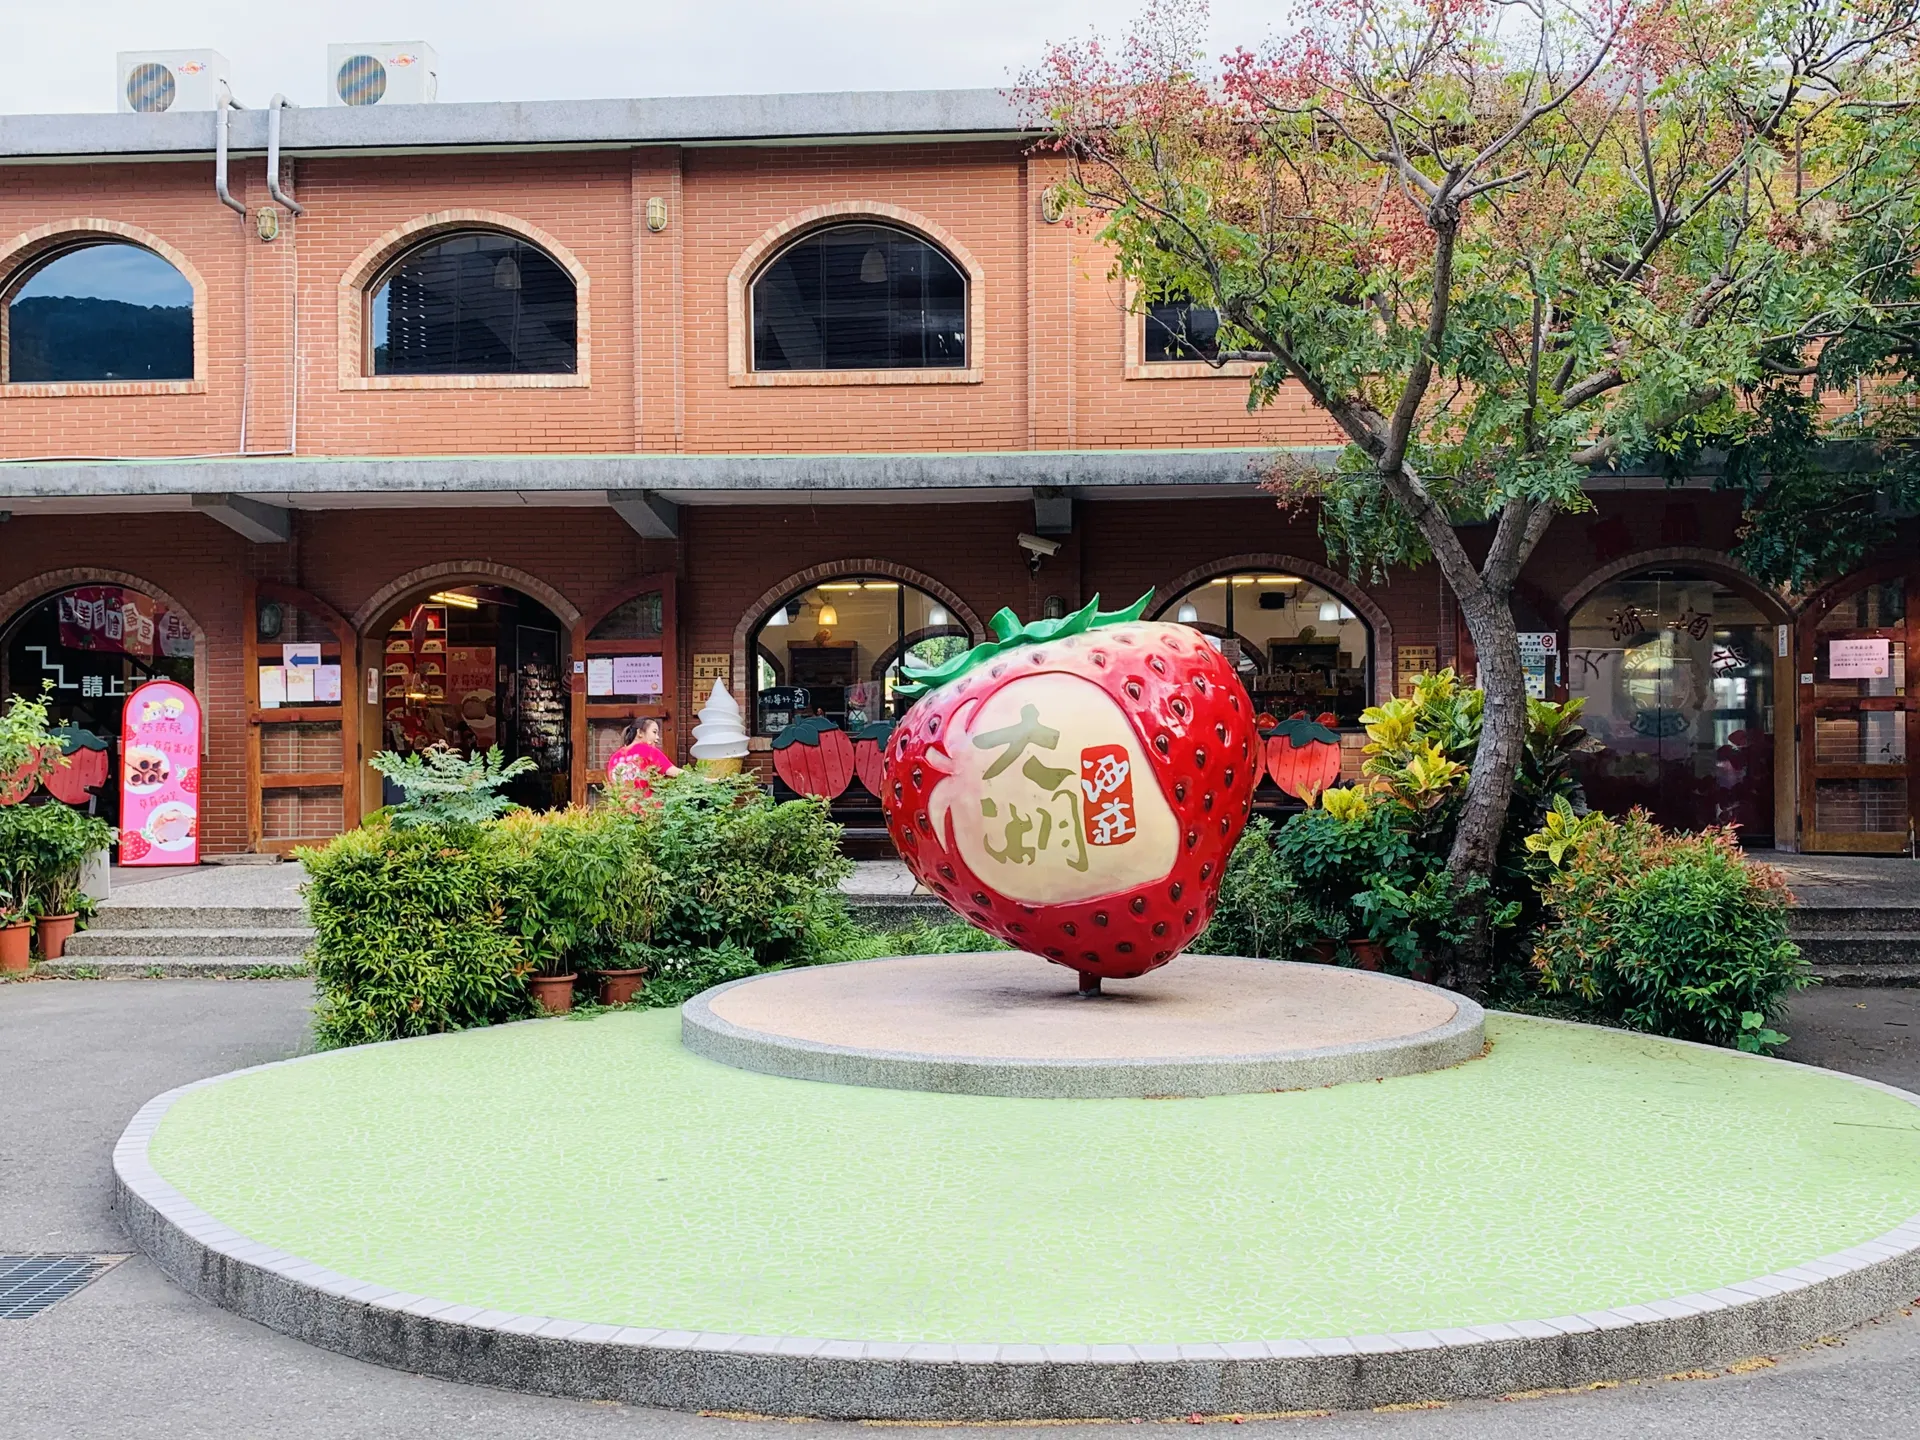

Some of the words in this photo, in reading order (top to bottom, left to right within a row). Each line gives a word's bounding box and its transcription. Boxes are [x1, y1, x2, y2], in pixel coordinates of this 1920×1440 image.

[82, 675, 170, 697] 請上二
[972, 704, 1089, 872] 大湖
[1081, 754, 1136, 844] 酒莊
